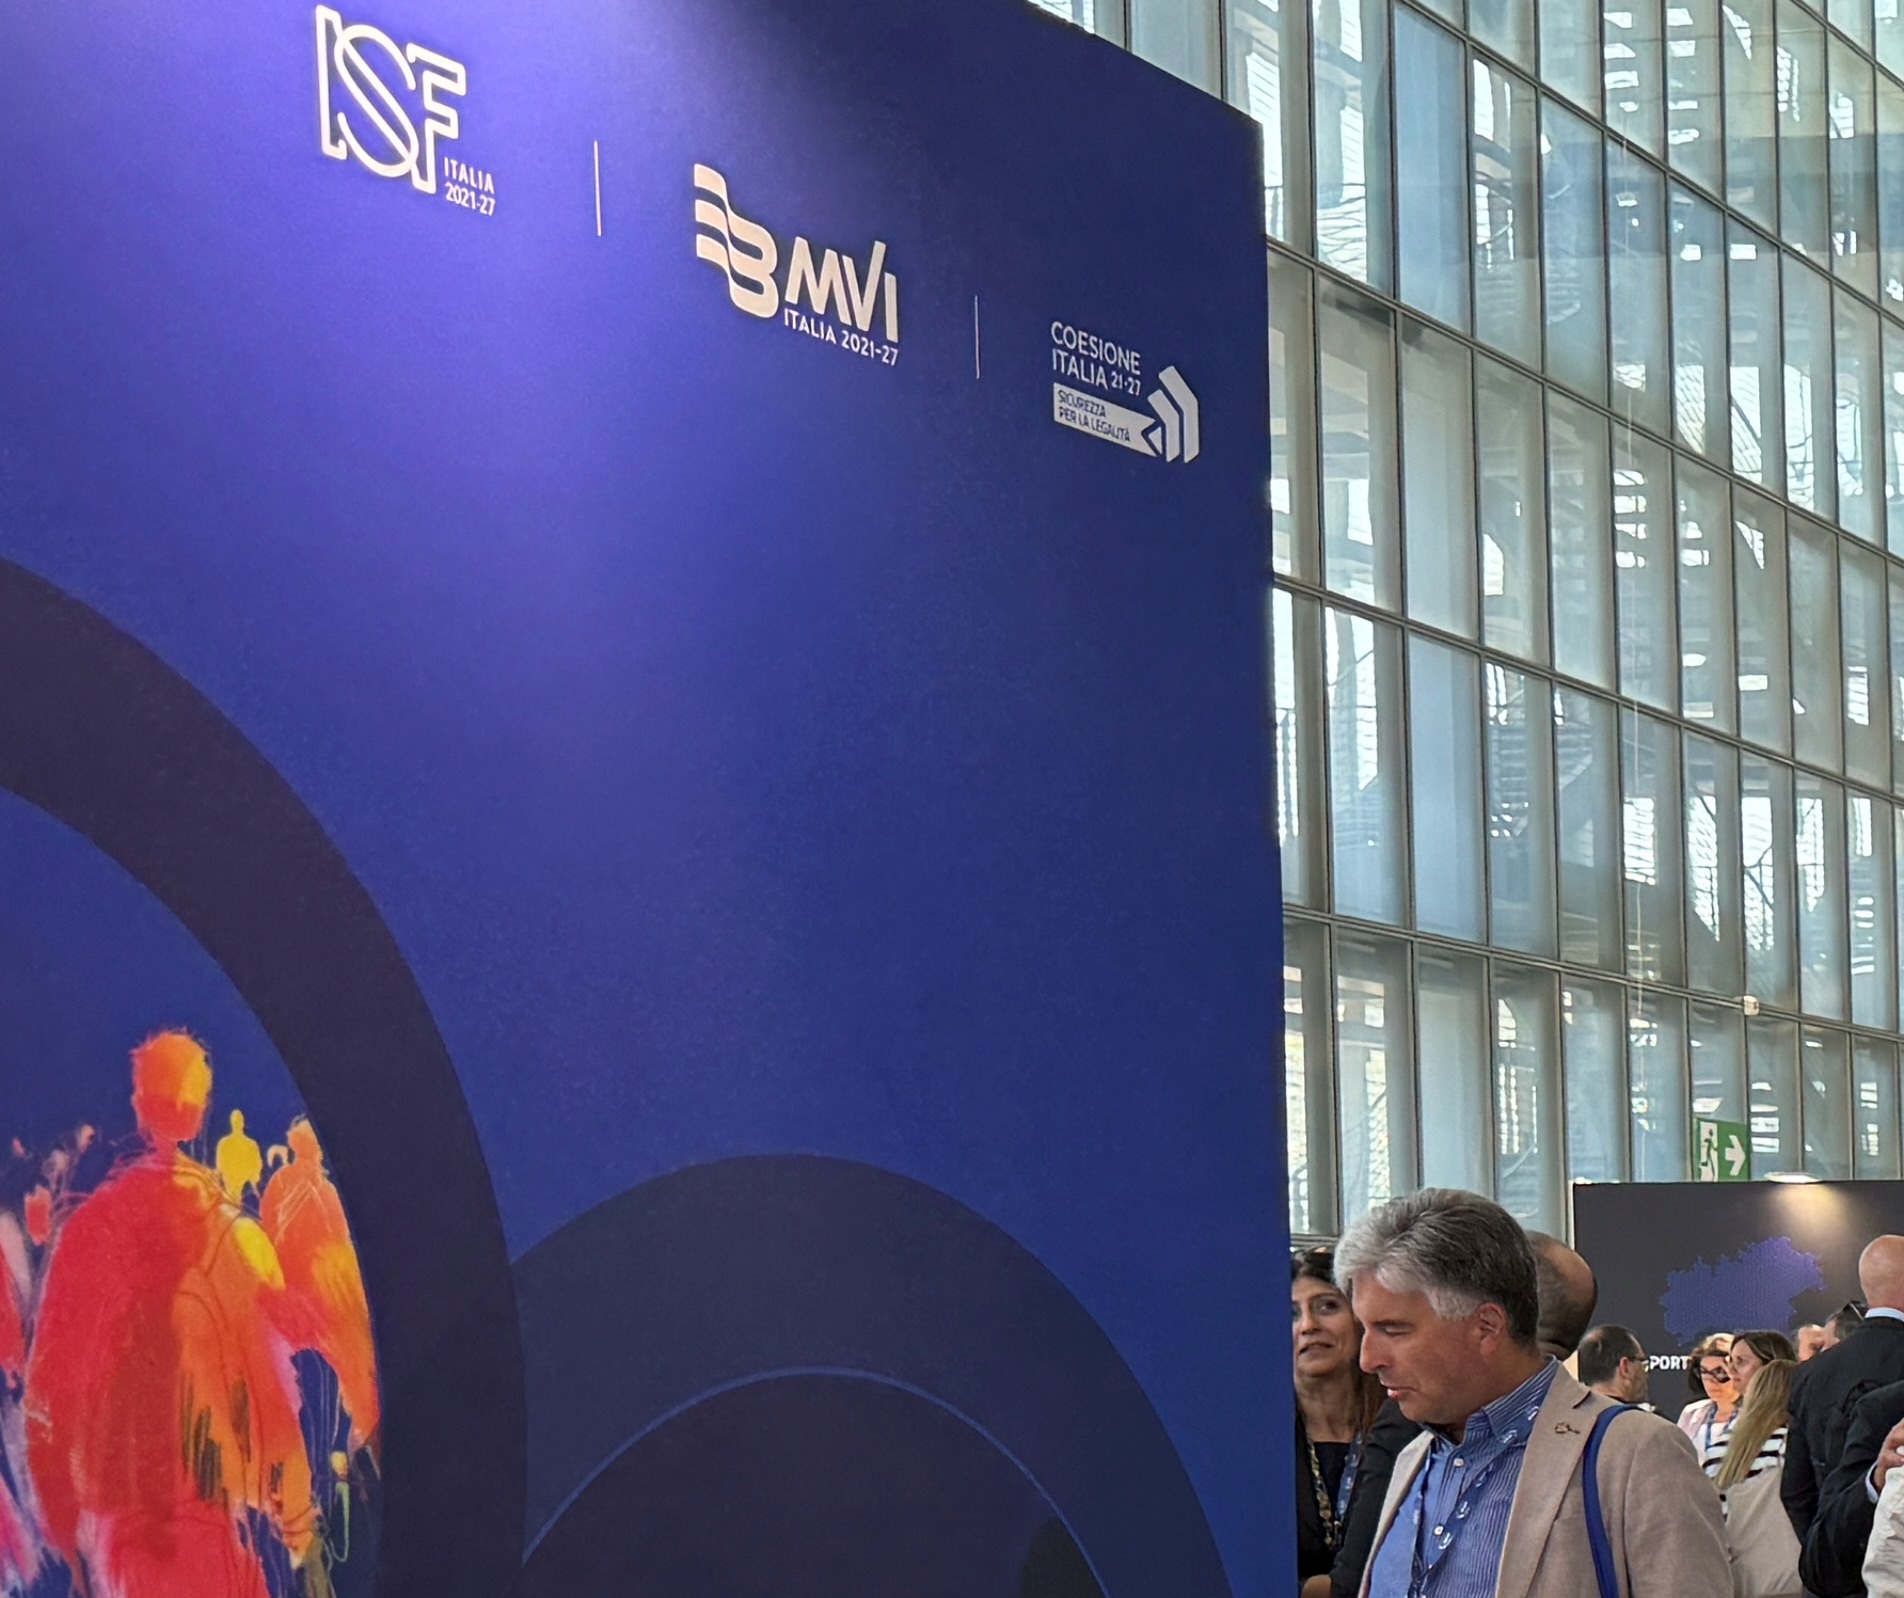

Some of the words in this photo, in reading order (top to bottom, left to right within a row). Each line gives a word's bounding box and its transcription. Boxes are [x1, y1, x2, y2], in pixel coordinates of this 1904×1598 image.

[316, 5, 466, 193] ISF
[444, 156, 495, 194] ITALIA
[445, 182, 496, 216] 2021-27
[784, 307, 836, 345] ITALIA
[841, 329, 898, 367] 2021-27
[1051, 321, 1141, 375] COESIONE
[1052, 348, 1108, 391] ITALIA
[1058, 389, 1107, 418] SICUREZZA
[1058, 406, 1077, 421] PER
[1078, 412, 1090, 428] LA
